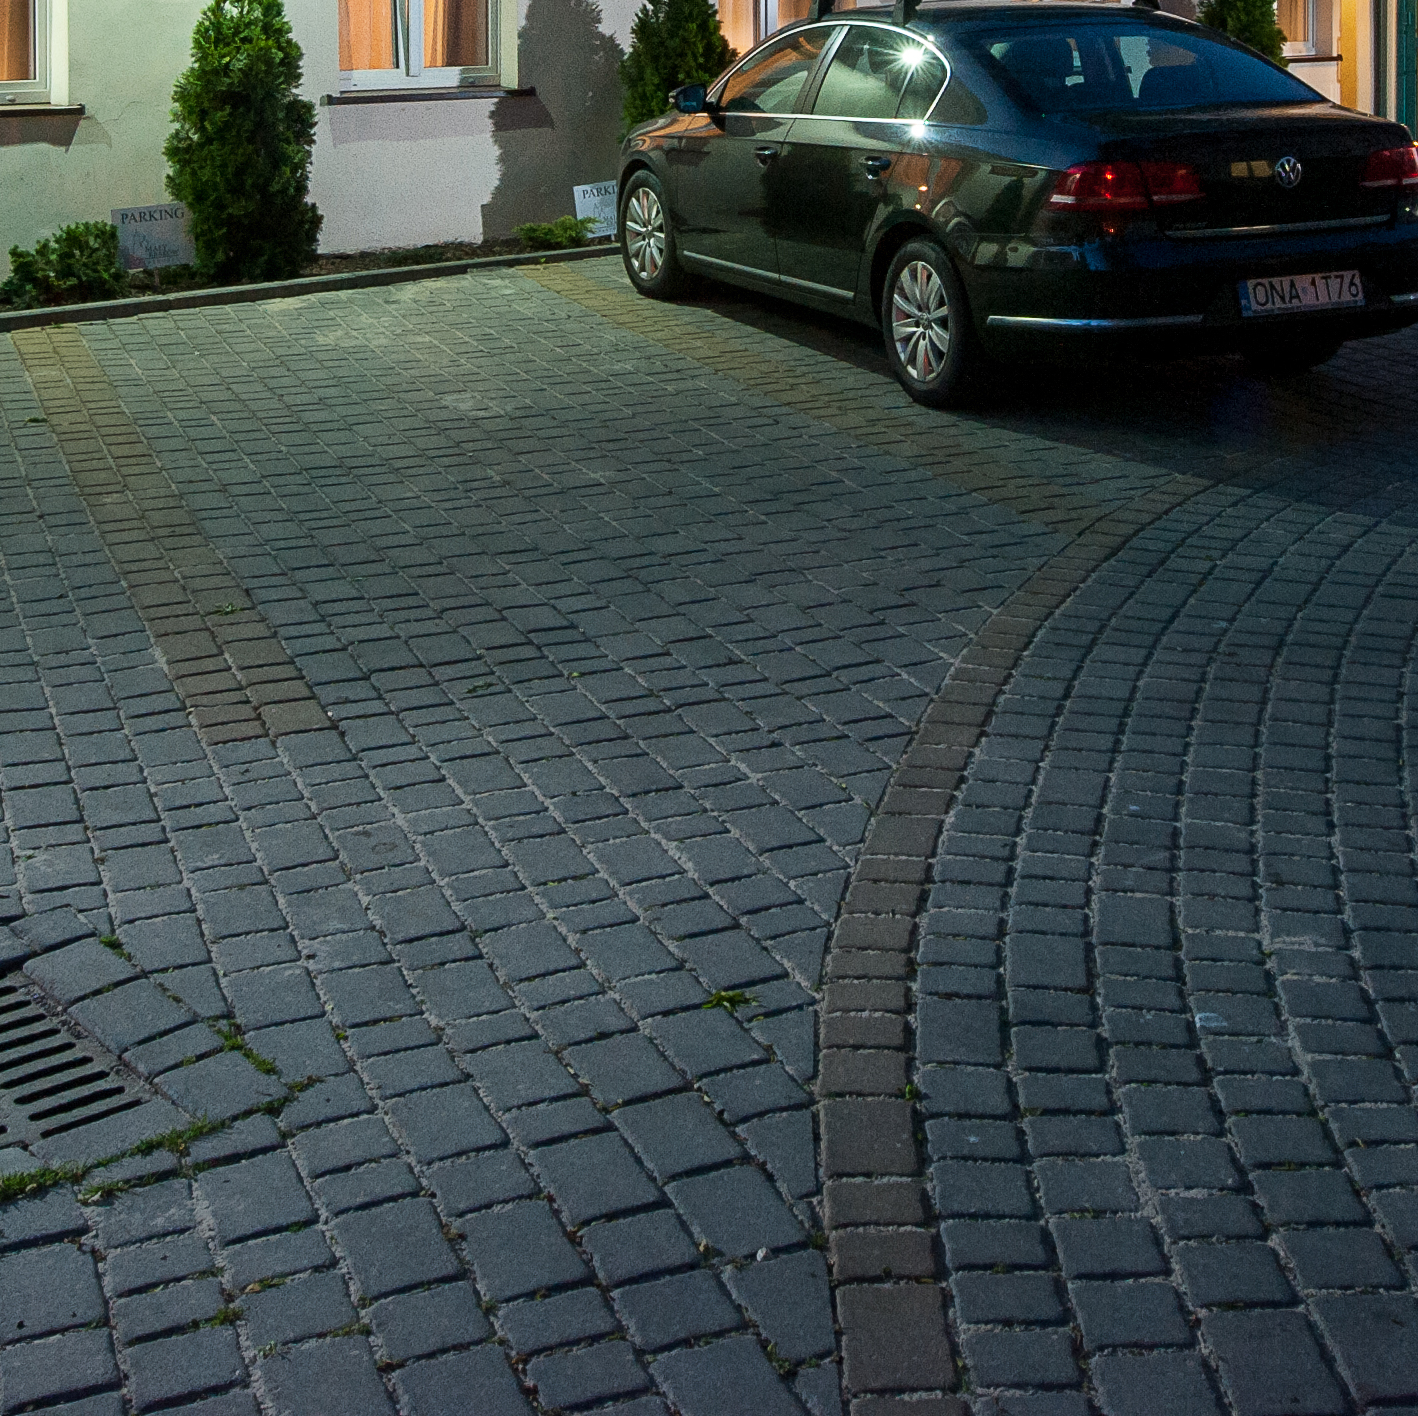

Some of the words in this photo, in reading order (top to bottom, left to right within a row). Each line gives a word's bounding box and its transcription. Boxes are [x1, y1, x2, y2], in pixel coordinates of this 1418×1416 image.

[582, 185, 616, 199] PARKI
[121, 207, 185, 224] PARKING
[1252, 279, 1302, 306] ONA
[1310, 273, 1360, 301] 1T76
